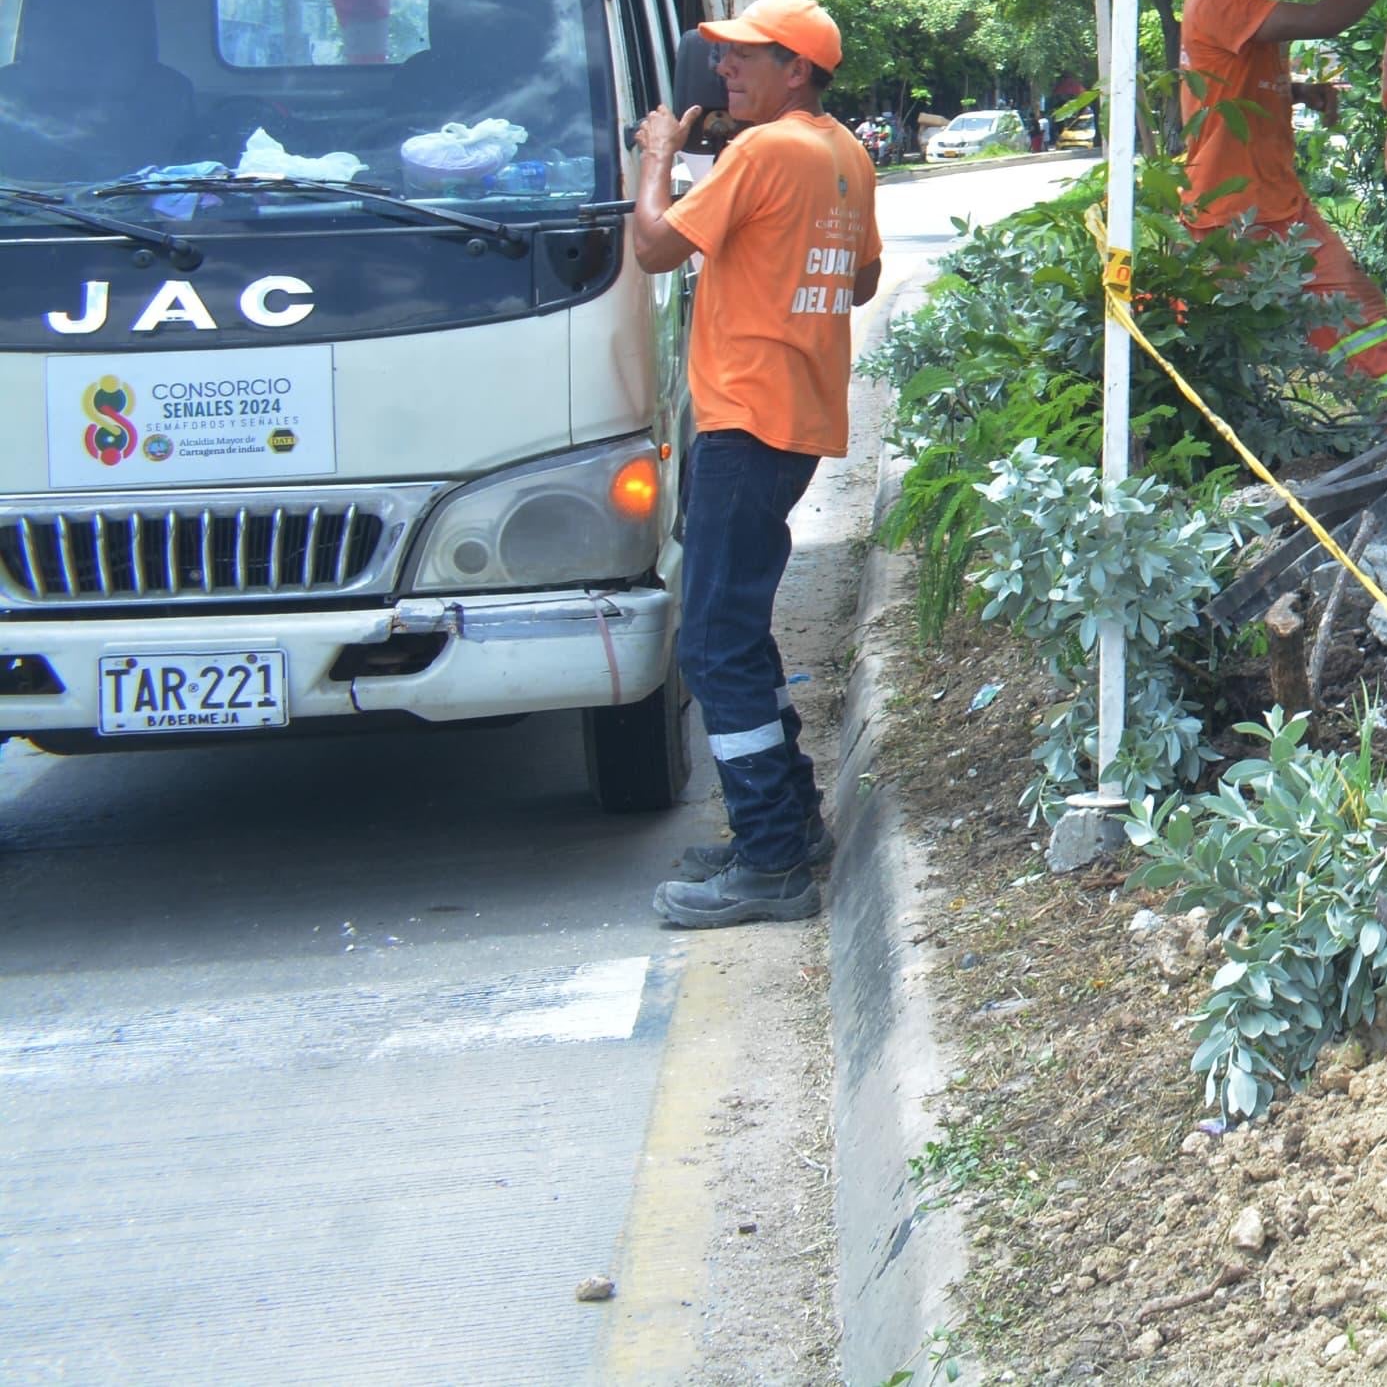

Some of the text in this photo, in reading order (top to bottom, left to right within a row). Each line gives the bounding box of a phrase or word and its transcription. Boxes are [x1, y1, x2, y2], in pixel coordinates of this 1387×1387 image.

[47, 275, 315, 334] JAC
[791, 287, 828, 314] DEL
[152, 377, 292, 401] CONSORCIO
[163, 398, 282, 419] SEÑALES 2024
[230, 419, 236, 428] Y
[240, 415, 300, 427] SEÑALES
[216, 437, 243, 448] Mayor
[245, 435, 256, 445] de
[179, 447, 226, 458] Cartagena
[147, 712, 240, 727] B/BERMEJA
